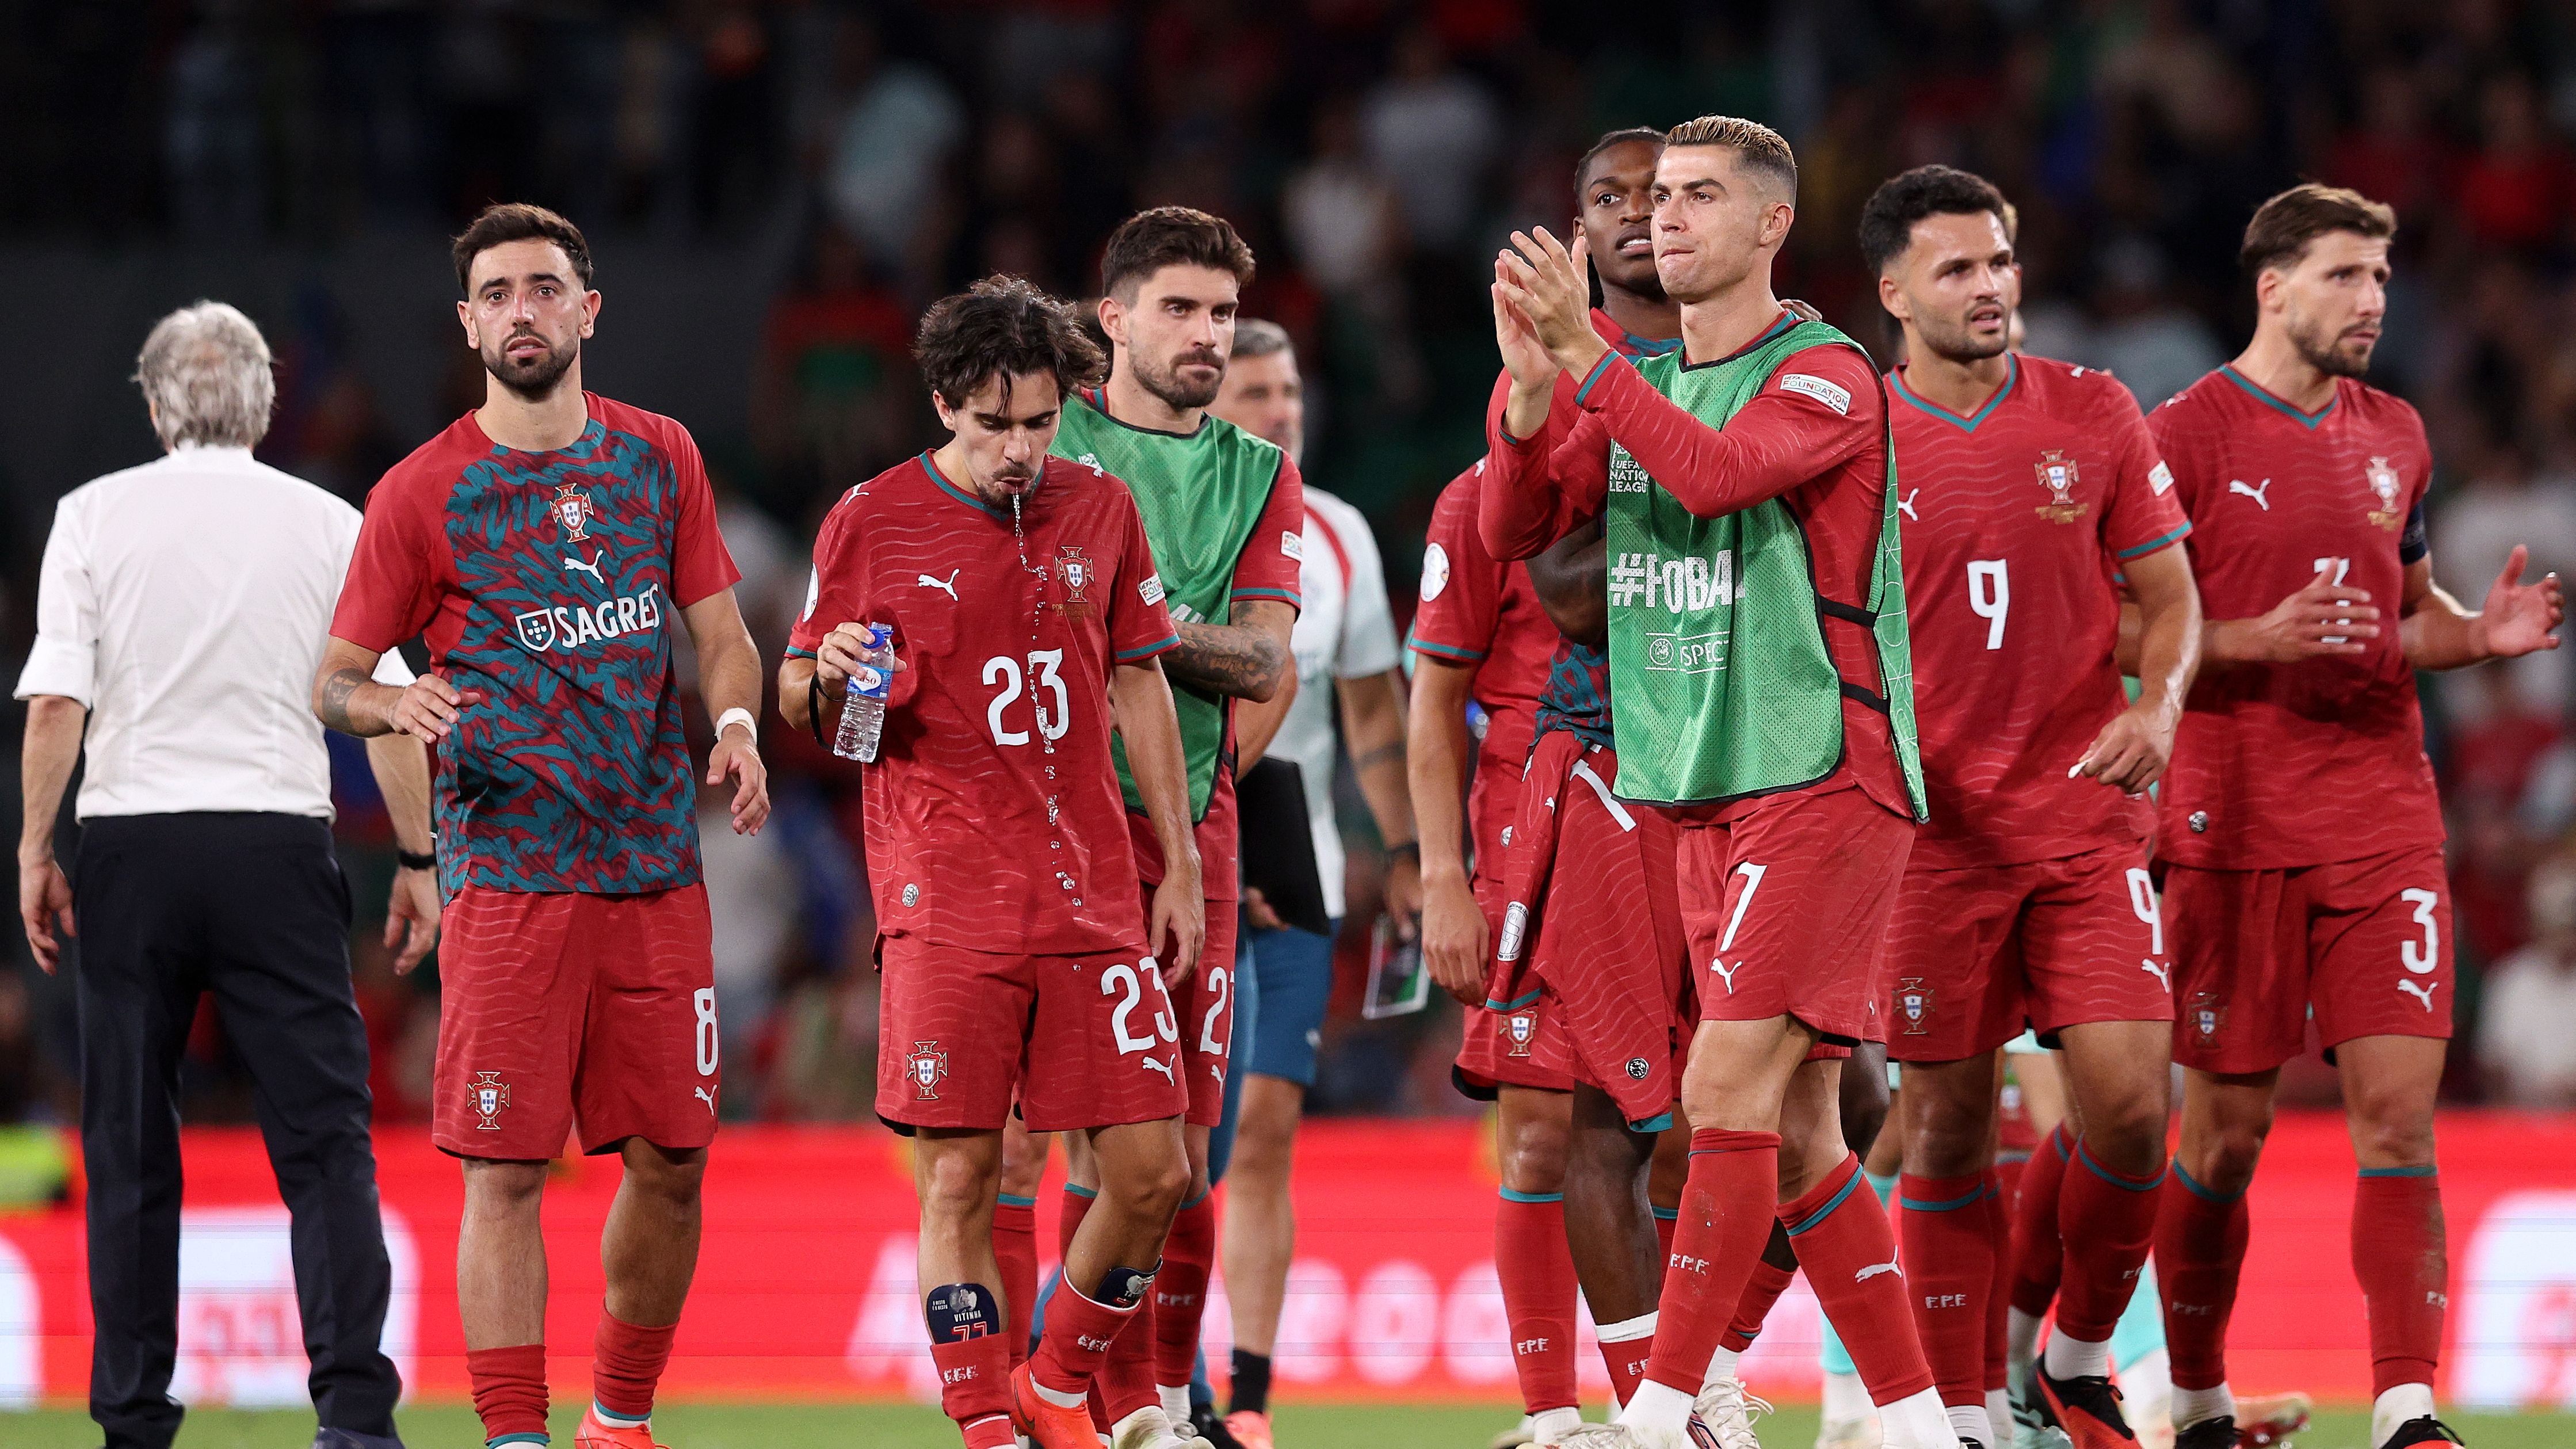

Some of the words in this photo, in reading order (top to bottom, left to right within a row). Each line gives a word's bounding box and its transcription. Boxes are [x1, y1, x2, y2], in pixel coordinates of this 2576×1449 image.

[1783, 380, 1848, 407] FOUNDATION
[1609, 481, 1647, 493] LEAGU
[1616, 460, 1640, 470] UEFA
[554, 583, 660, 649] SAGRES
[1967, 559, 2009, 650] 9
[982, 648, 1070, 746] 23
[1720, 861, 1768, 952] 7
[2125, 867, 2163, 955] 9
[2400, 888, 2438, 974] 3
[693, 985, 719, 1077] 8
[1100, 956, 1178, 1056] 23
[953, 1310, 982, 1322] VITINHA
